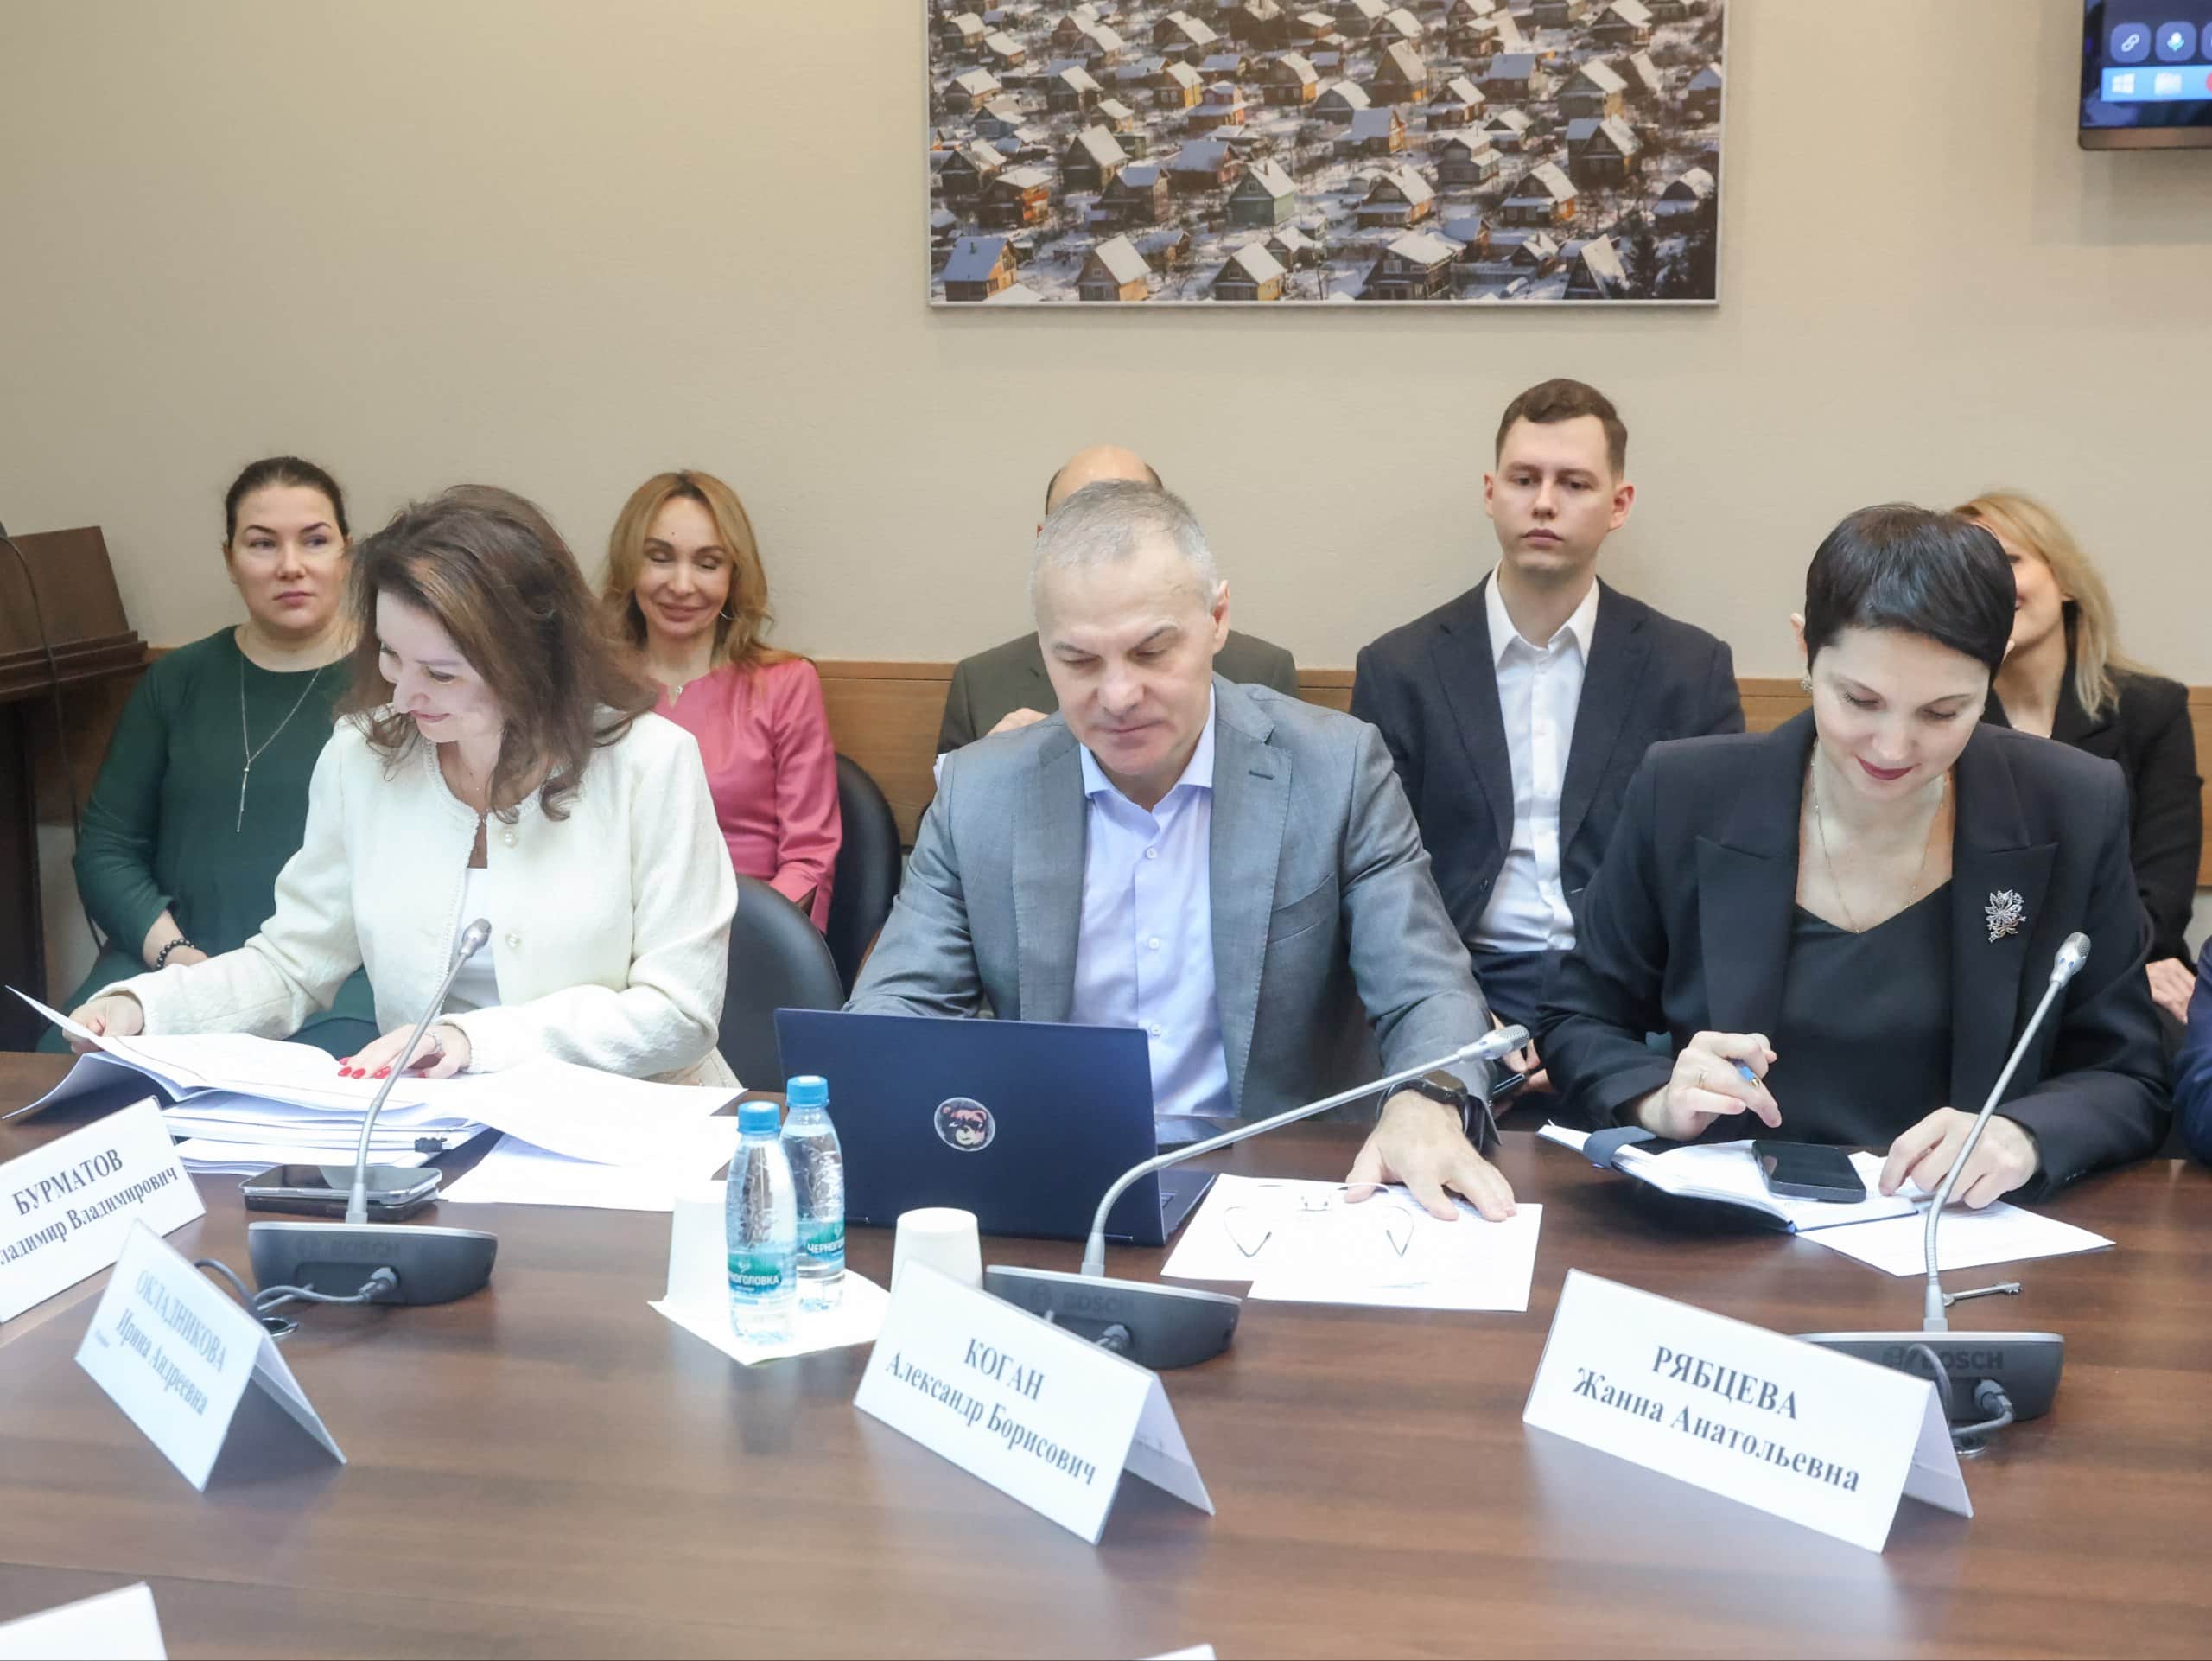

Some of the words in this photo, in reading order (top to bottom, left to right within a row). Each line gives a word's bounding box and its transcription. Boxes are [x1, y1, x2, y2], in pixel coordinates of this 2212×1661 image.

[12, 1149, 123, 1216] БУРМАТОВ
[66, 1167, 178, 1231] Владимирович
[116, 1308, 152, 1359] Ирина
[149, 1345, 208, 1416] Андреевна
[137, 1270, 226, 1372] ОКЛАДНИКОВА
[964, 1338, 1045, 1401] КОГАН
[1652, 1346, 1798, 1420] РЯБЦЕВА
[885, 1352, 984, 1427] Александр
[988, 1403, 1096, 1486] Борисович
[1573, 1367, 1664, 1422] Жанна
[1670, 1405, 1859, 1492] Анатольевна
